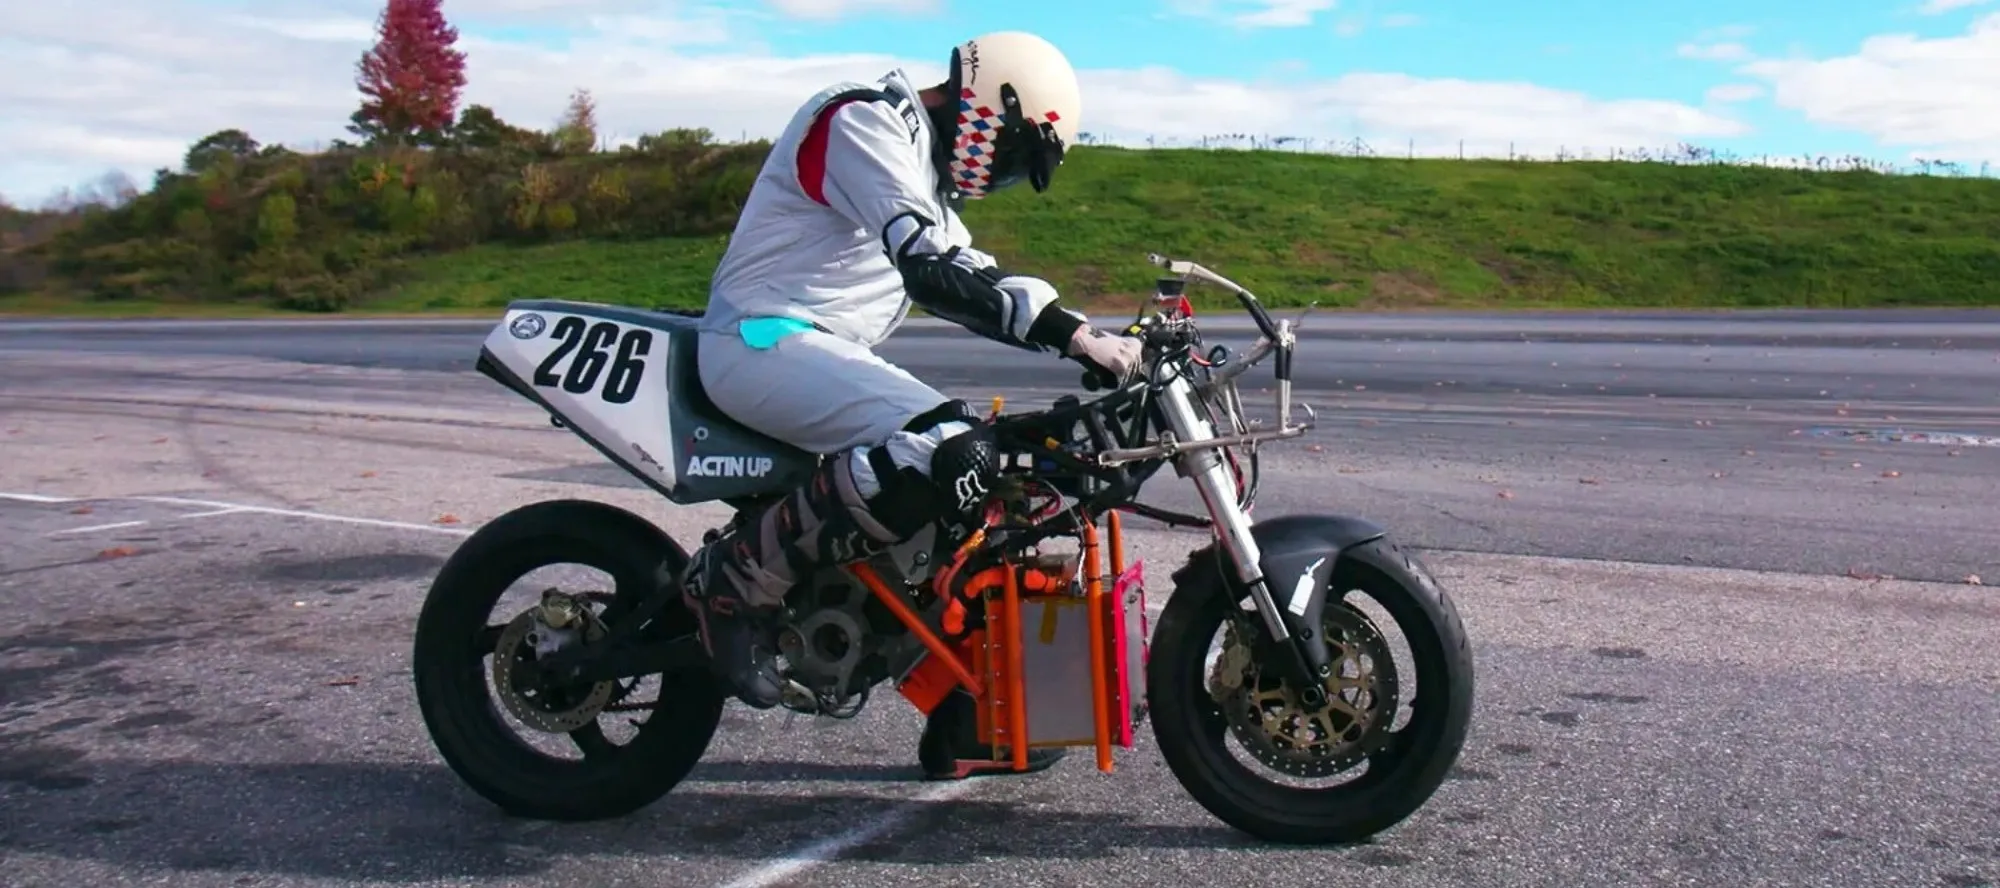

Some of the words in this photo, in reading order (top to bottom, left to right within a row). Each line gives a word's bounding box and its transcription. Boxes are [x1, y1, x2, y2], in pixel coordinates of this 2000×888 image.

[533, 316, 653, 404] 266
[686, 455, 744, 477] ACTIN
[747, 457, 773, 477] UP
